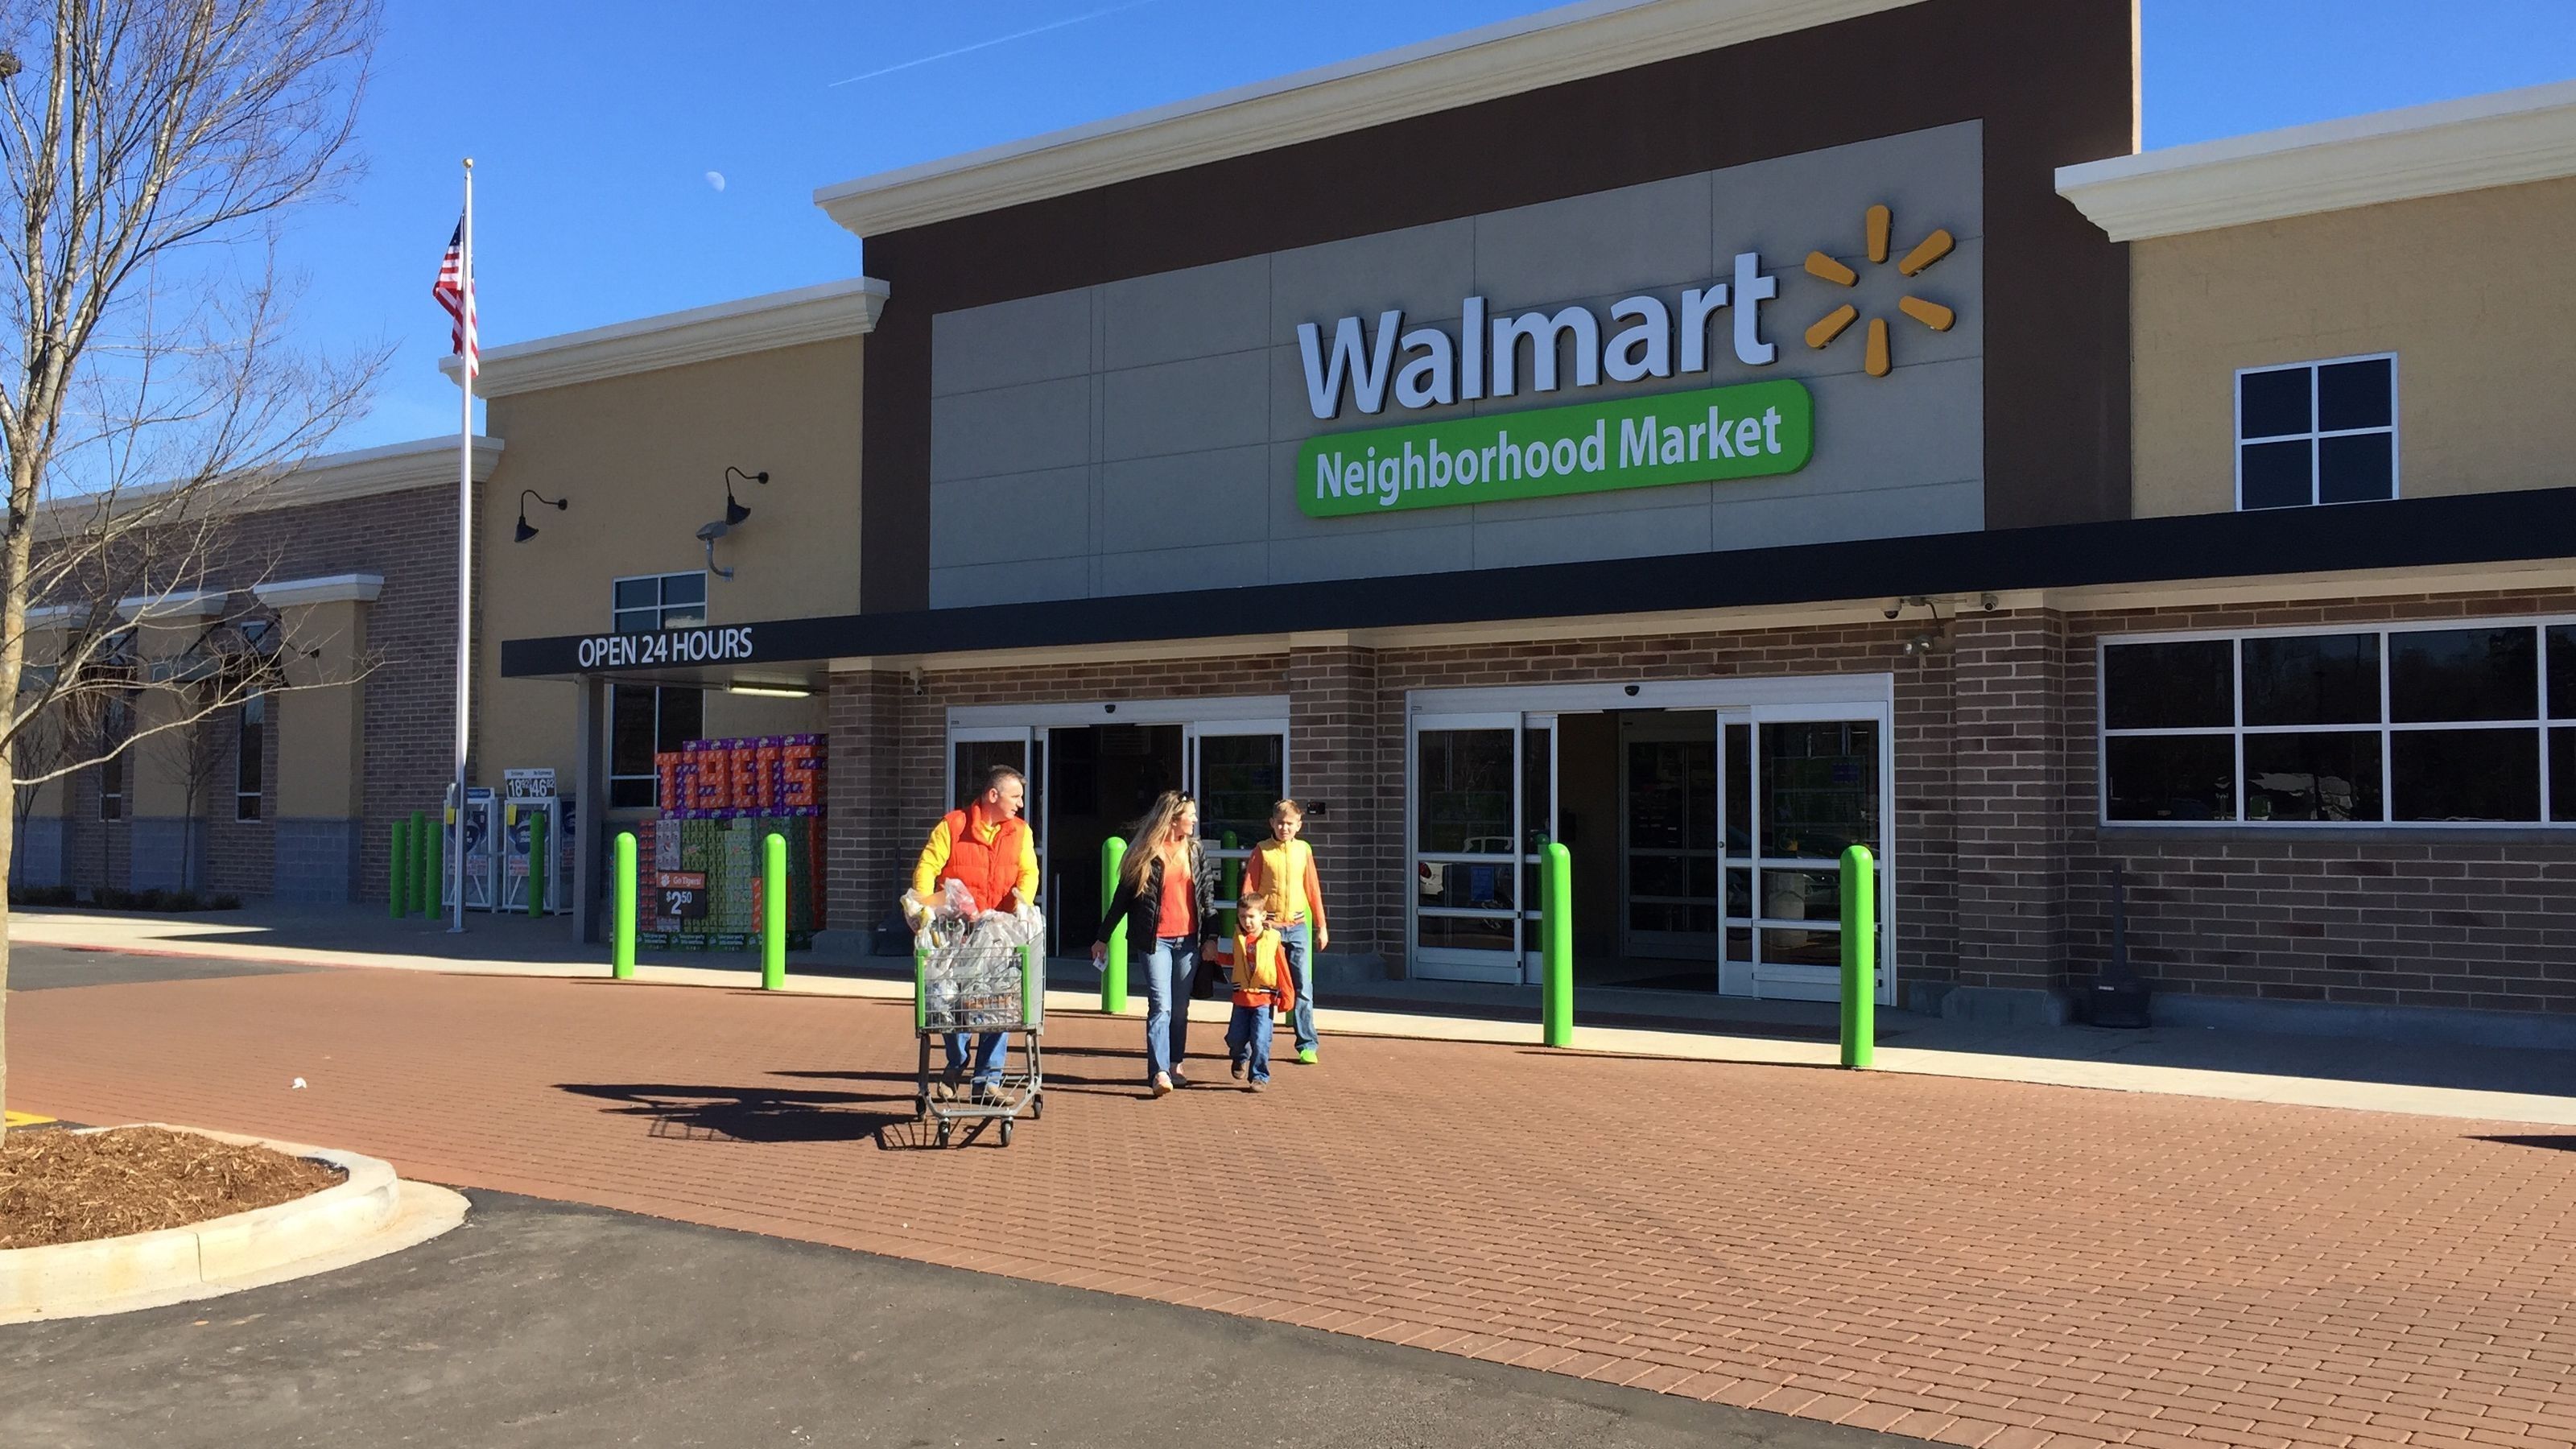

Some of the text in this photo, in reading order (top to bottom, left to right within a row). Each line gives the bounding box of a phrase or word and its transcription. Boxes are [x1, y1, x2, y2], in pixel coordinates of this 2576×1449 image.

[1297, 251, 1777, 420] Walmart
[1316, 405, 1782, 506] Neighborhood Market
[578, 626, 753, 668] OPEN 24 HOURS
[673, 876, 702, 887] Go Tigers!
